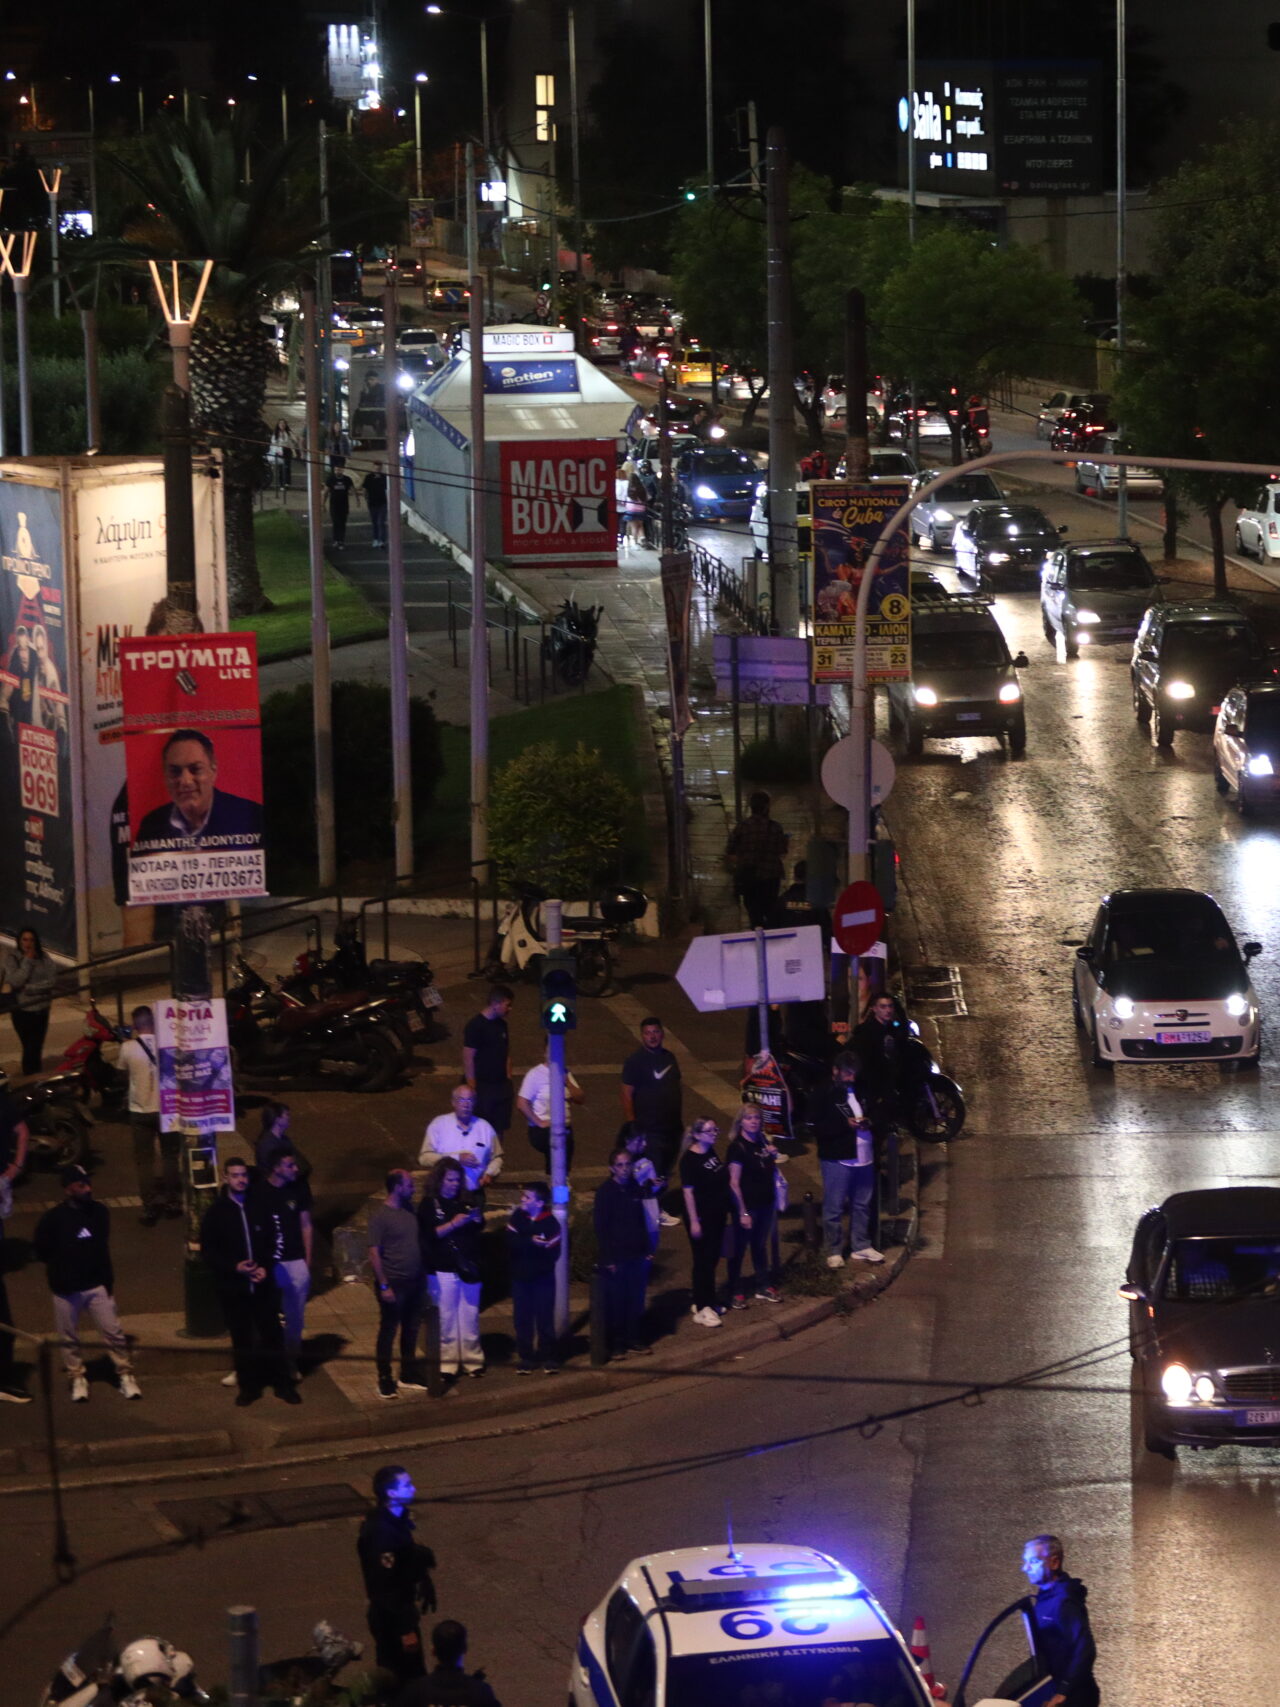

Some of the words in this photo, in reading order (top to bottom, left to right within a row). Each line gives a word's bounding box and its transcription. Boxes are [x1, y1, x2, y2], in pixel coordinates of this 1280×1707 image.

[492, 334, 520, 346] MAGIC
[523, 334, 540, 346] BOX
[502, 370, 554, 385] motion
[849, 497, 901, 507] NATIONAL
[511, 496, 574, 535] BOX
[842, 506, 885, 528] Cuba
[96, 515, 152, 551] λάμψη
[815, 624, 871, 636] ΚΑΜΑΤΕΟ
[817, 654, 832, 666] 31
[890, 652, 907, 664] 23
[219, 668, 252, 680] LIVE
[21, 729, 56, 750] ATHENS
[23, 770, 57, 812] 969
[132, 836, 197, 851] ΔΙΑΜΑΝΤΗΣ
[200, 833, 262, 847] ΔΙΟΝΥΣΙΟΥ
[131, 860, 179, 874] ΝΟΤΑΡΑ
[182, 858, 199, 871] 119
[208, 854, 263, 869] ΠΕΙΡΑΙΑΣ
[180, 868, 264, 890] 6974703673
[708, 1650, 780, 1665] ΕΛΛΗΝΙΚΗ
[783, 1645, 861, 1657] ΑΣΤΥΝΟΜΙΑ
